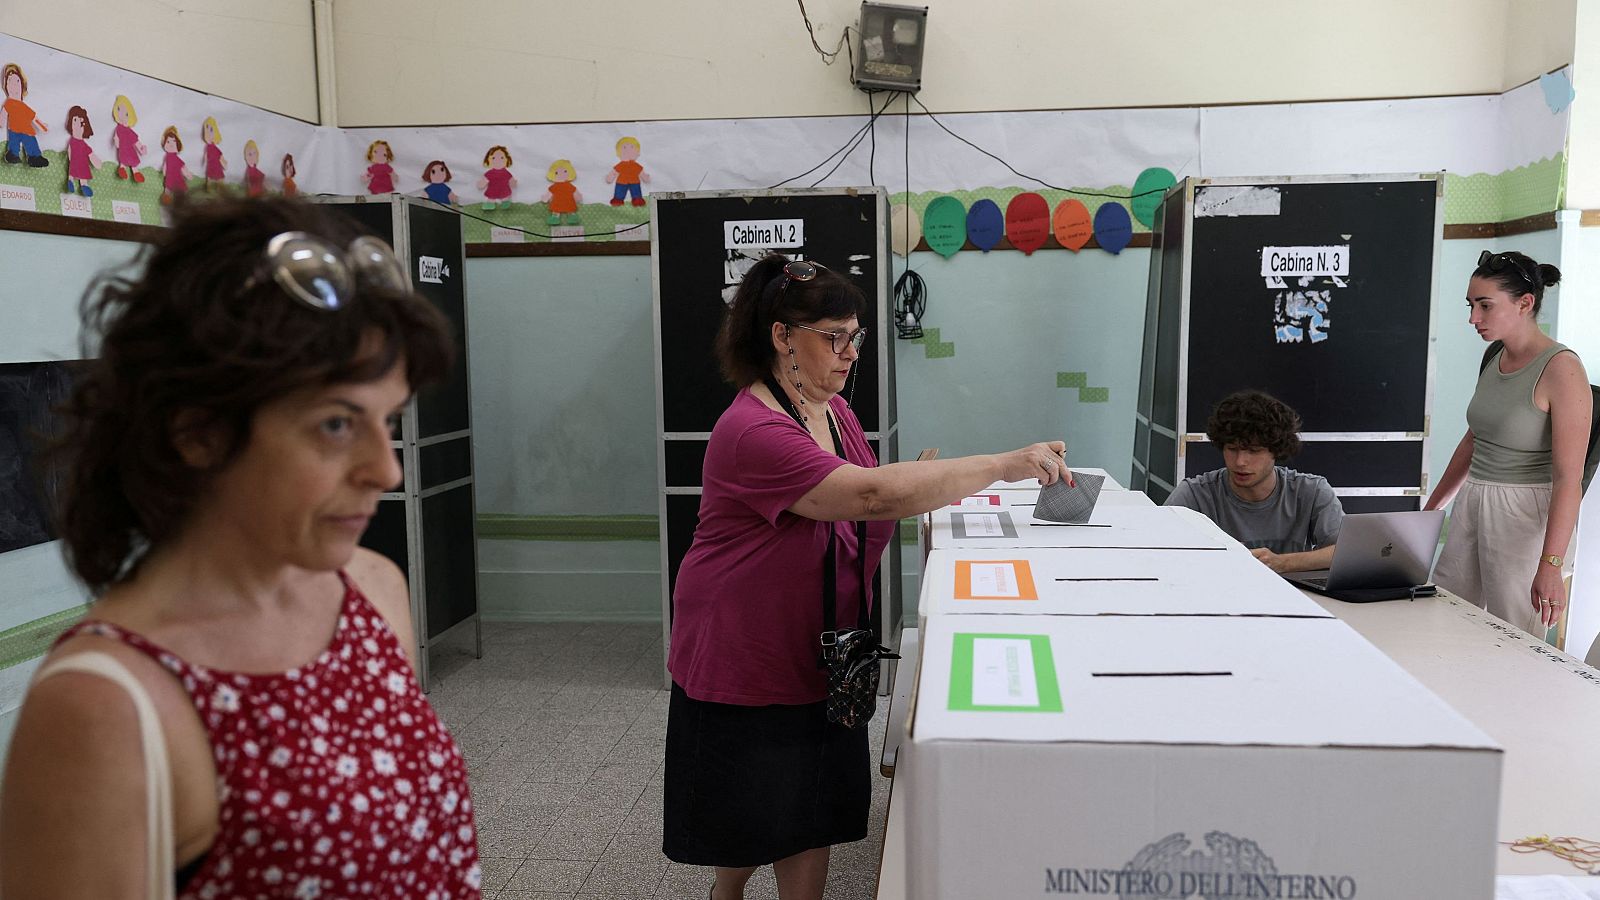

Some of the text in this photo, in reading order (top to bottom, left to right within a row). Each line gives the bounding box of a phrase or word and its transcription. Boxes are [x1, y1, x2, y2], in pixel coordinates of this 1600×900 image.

[1, 189, 32, 201] EDOARDO
[63, 198, 91, 213] SOLEIL
[732, 224, 796, 244] Cabina N. 2
[421, 260, 437, 279] Cabina
[1270, 252, 1340, 272] Cabina N. 3
[1045, 867, 1357, 900] MINISTERO DELL'INTERNO
